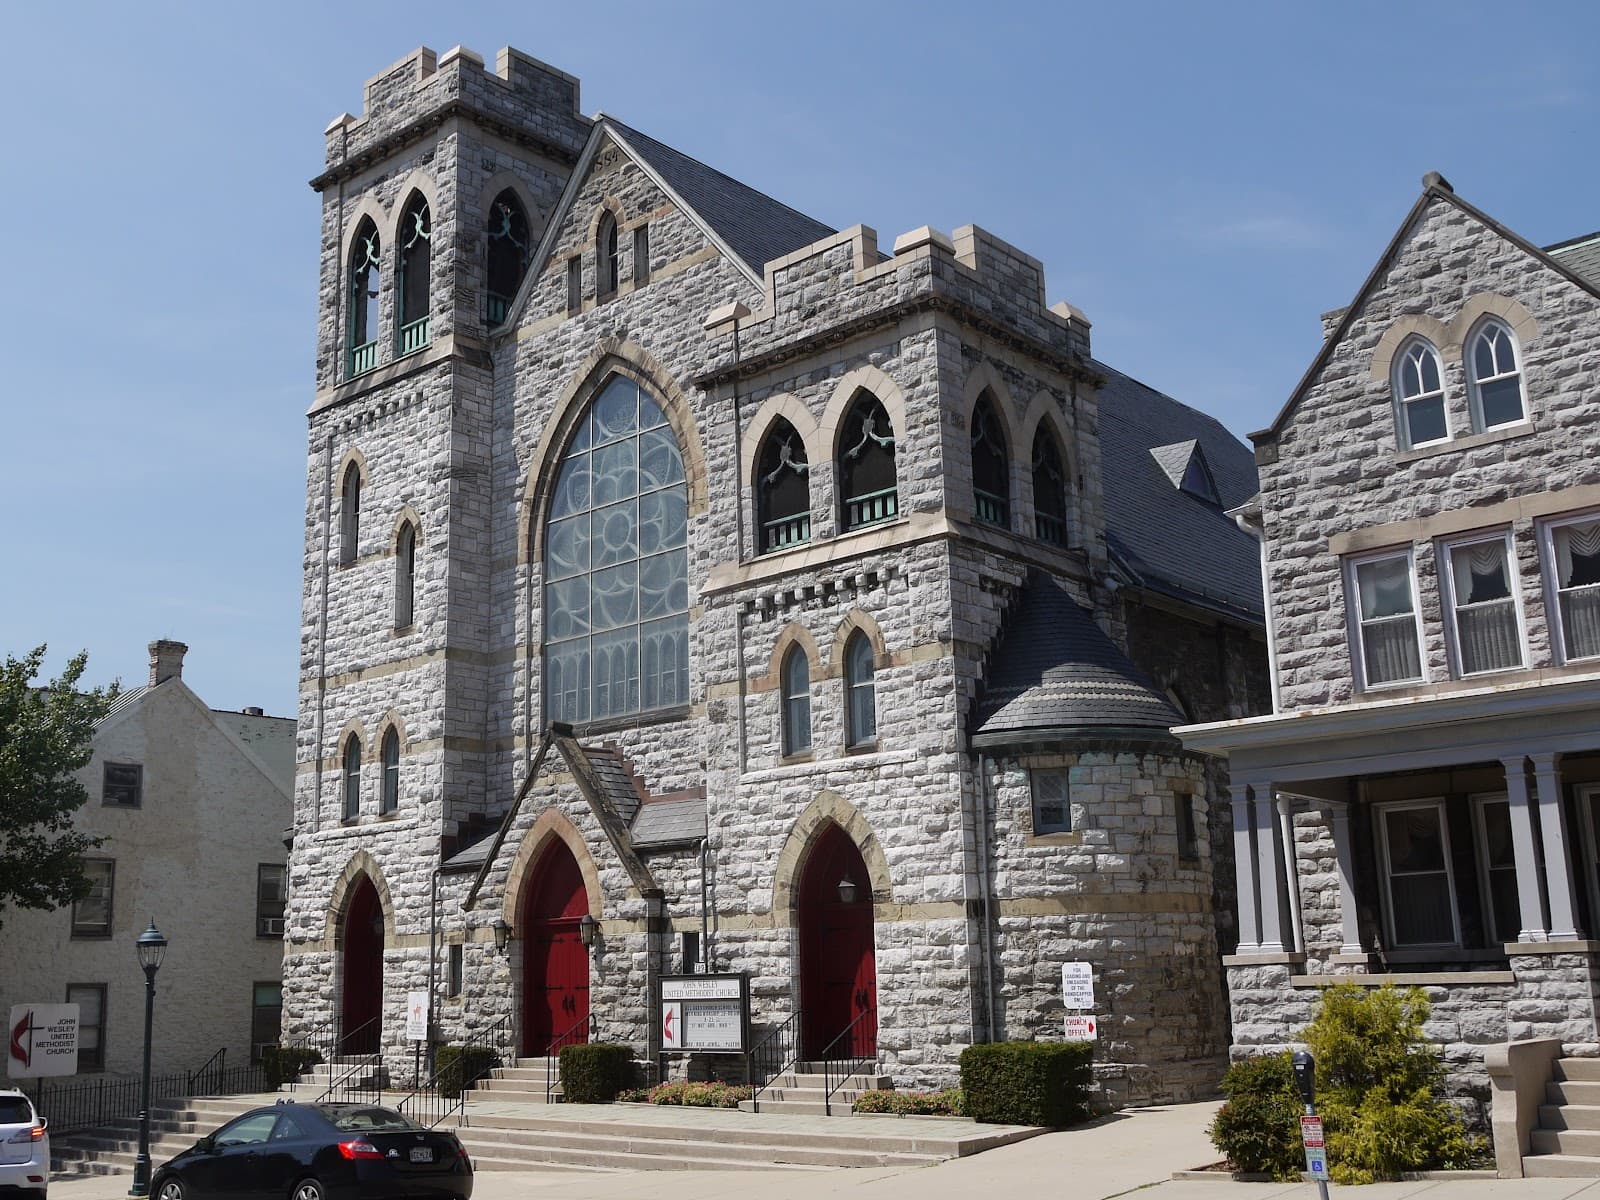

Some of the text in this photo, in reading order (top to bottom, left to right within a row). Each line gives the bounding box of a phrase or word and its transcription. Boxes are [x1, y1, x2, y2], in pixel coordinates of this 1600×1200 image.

[697, 980, 718, 989] WESLEY
[664, 987, 739, 998] UNITED METHODIST CHURCH
[1065, 1018, 1087, 1026] CHURCH
[47, 1025, 75, 1033] WESLEY
[1067, 1029, 1086, 1037] OFFICE
[35, 1040, 75, 1048] METHODIST
